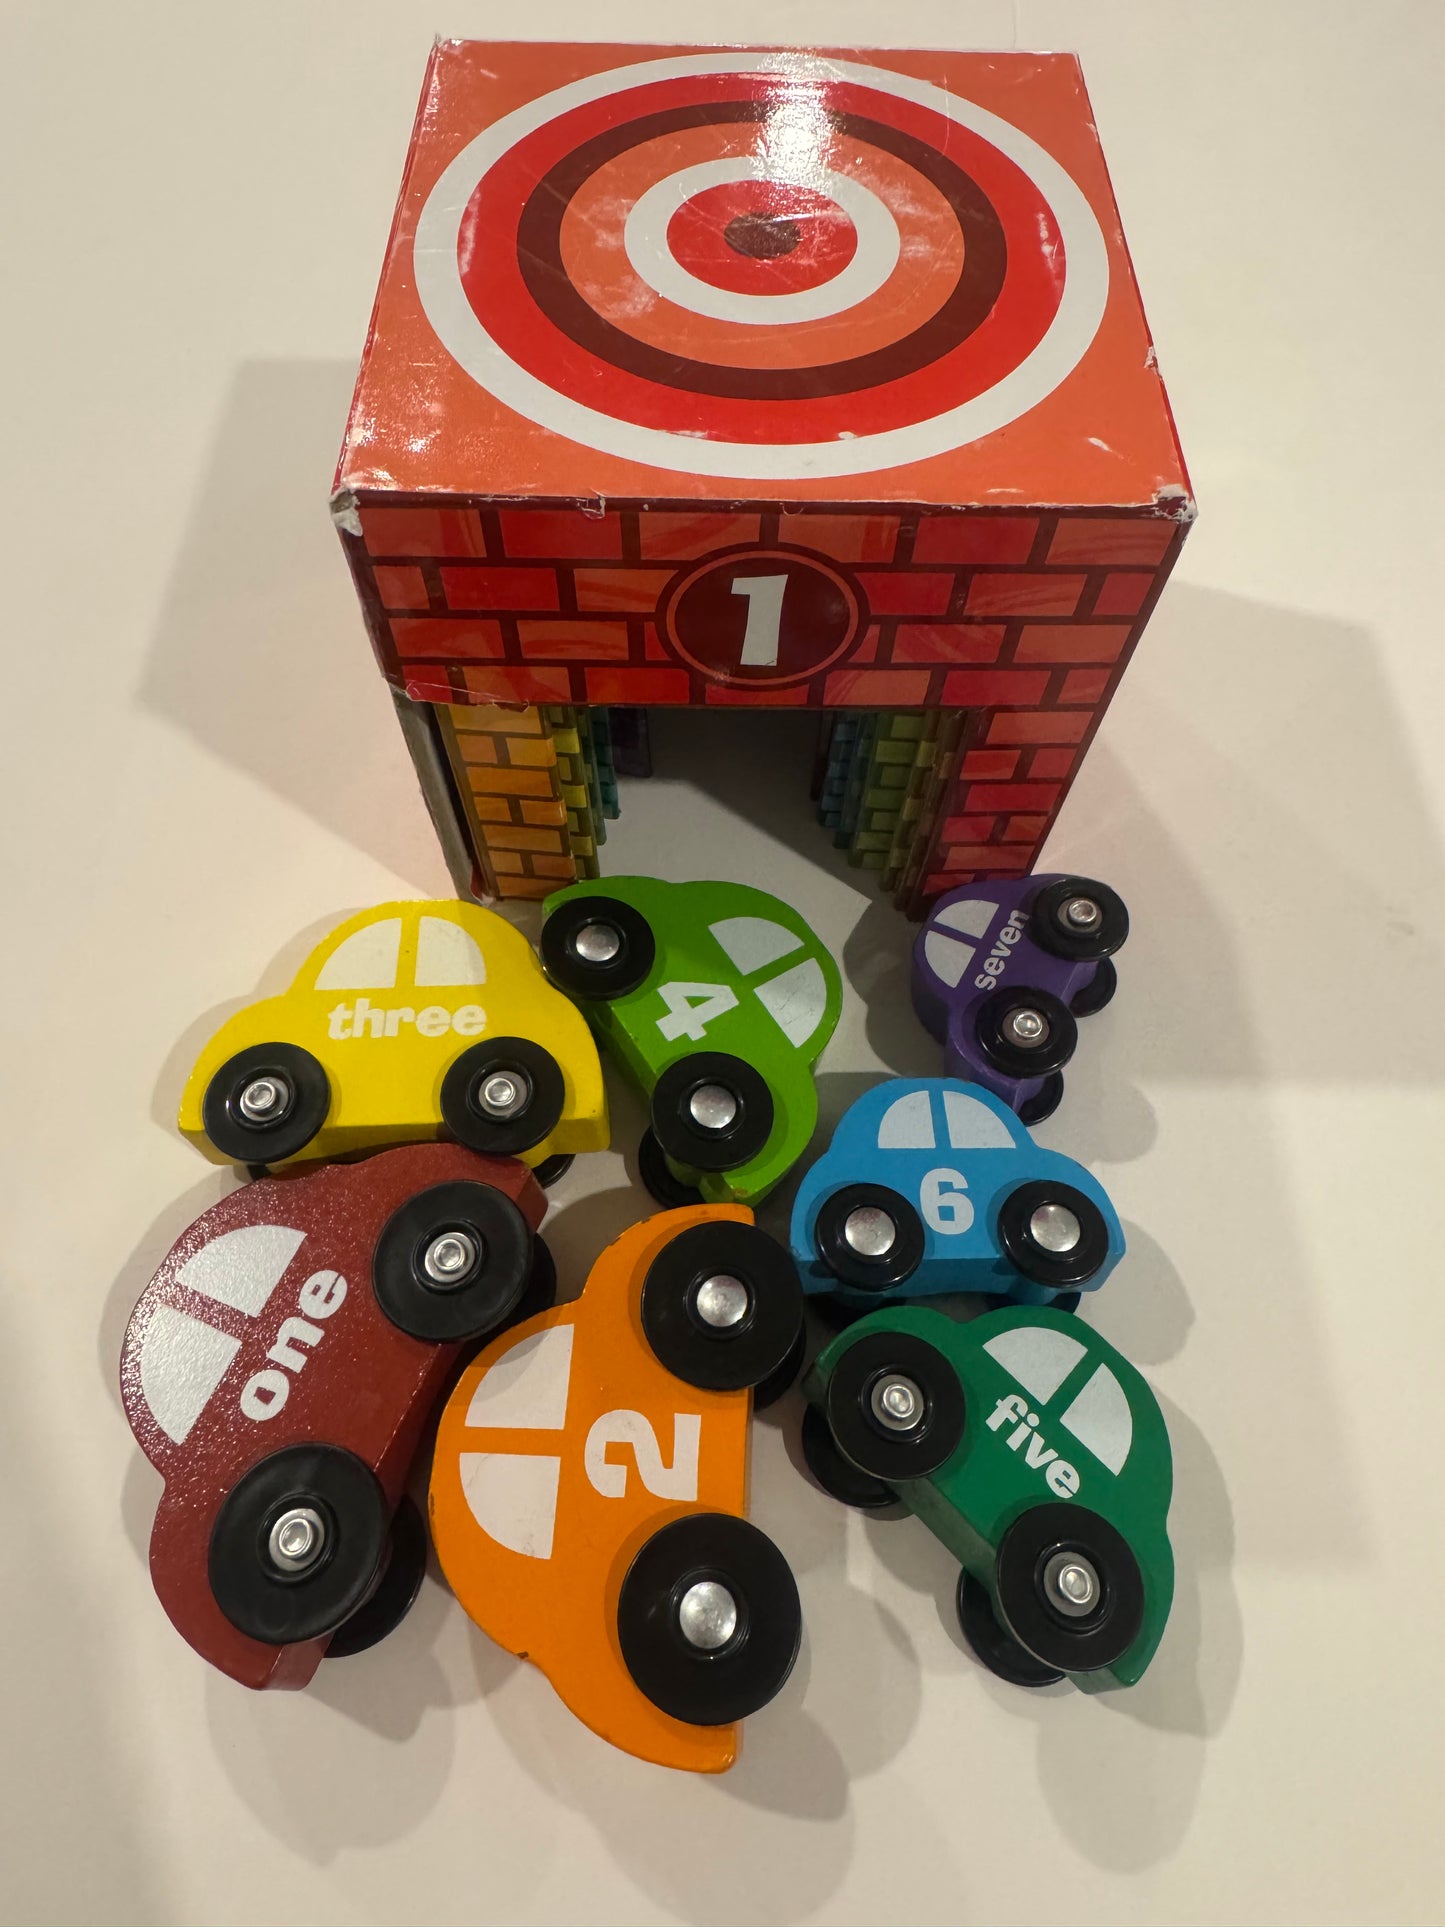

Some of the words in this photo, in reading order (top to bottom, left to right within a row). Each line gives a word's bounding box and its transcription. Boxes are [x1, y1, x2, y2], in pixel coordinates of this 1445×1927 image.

[730, 573, 789, 668] 1
[974, 909, 1029, 991] seven
[327, 998, 487, 1040] three
[655, 981, 740, 1042] 4
[919, 1167, 975, 1236] 6
[240, 1269, 349, 1423] one
[584, 1409, 702, 1502] 2
[985, 1393, 1081, 1500] five
